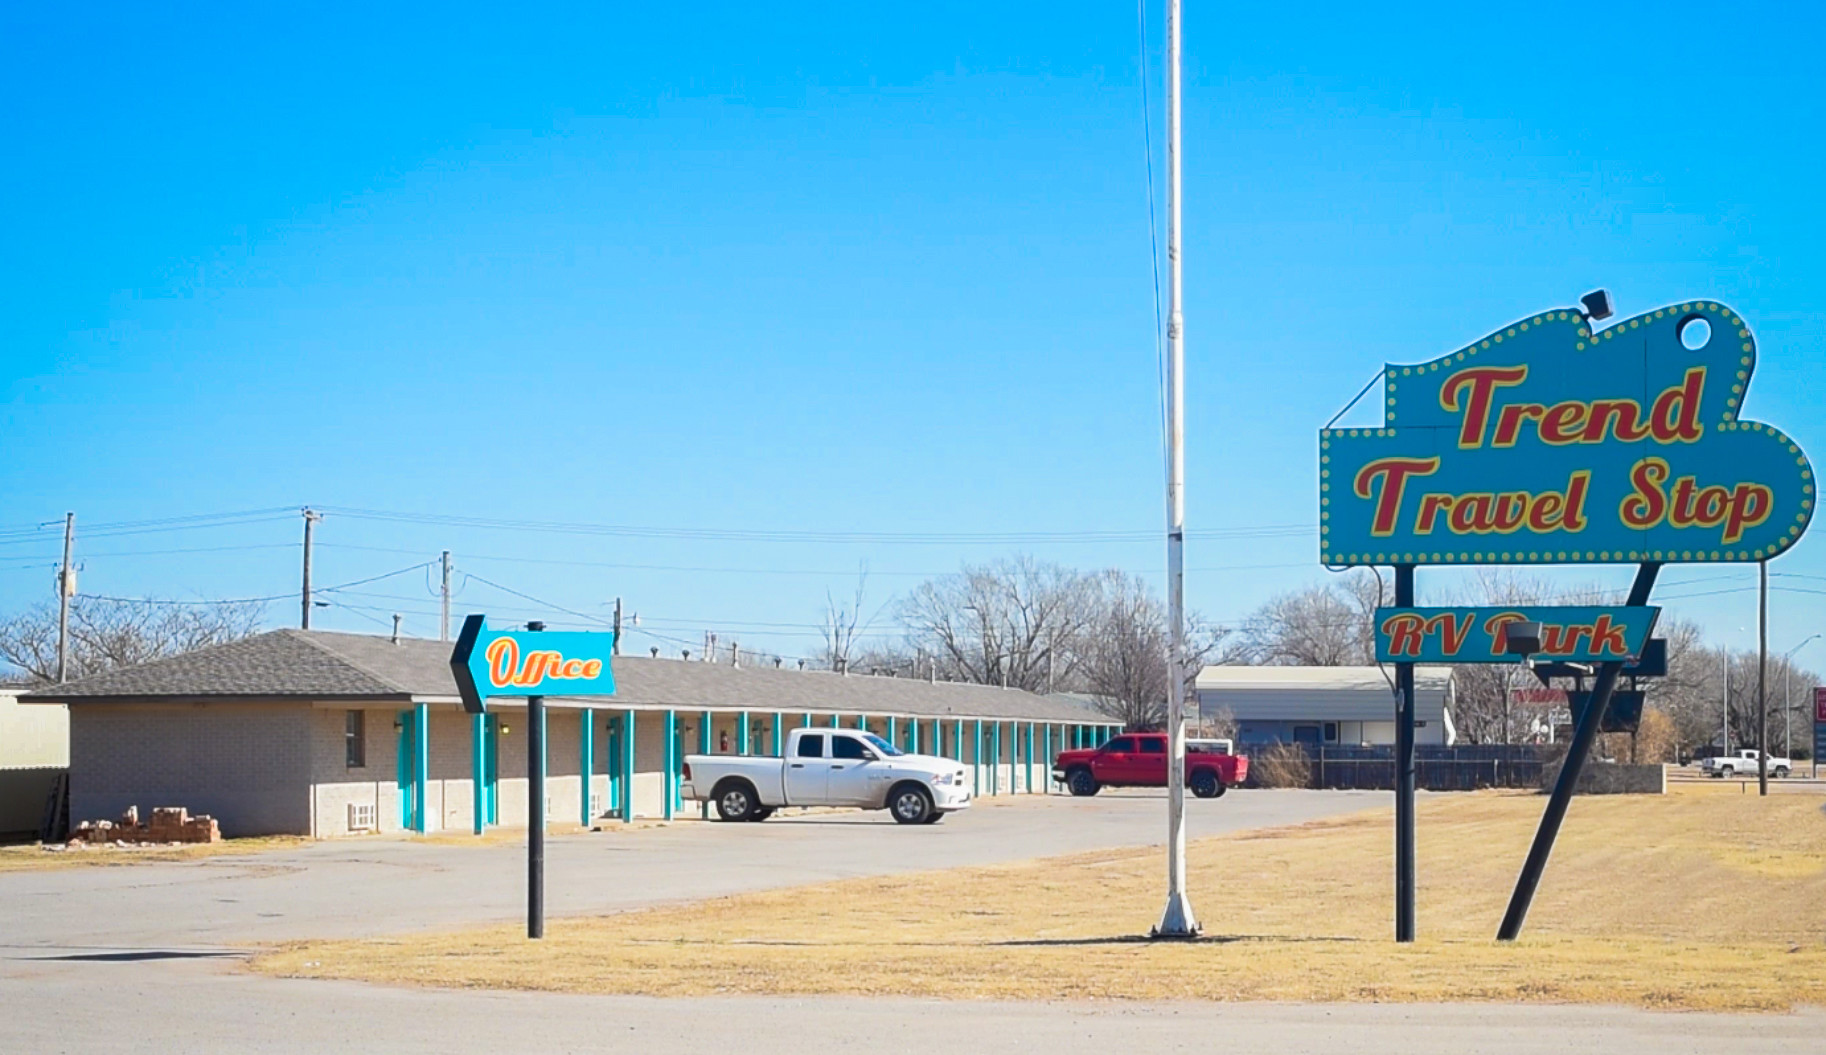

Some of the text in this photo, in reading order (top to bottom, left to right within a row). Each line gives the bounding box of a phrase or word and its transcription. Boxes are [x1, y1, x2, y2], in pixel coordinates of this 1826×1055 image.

[1440, 365, 1707, 449] Trend
[1354, 457, 1775, 544] Travel Stop
[485, 636, 602, 688] Office
[1381, 612, 1476, 656] RV
